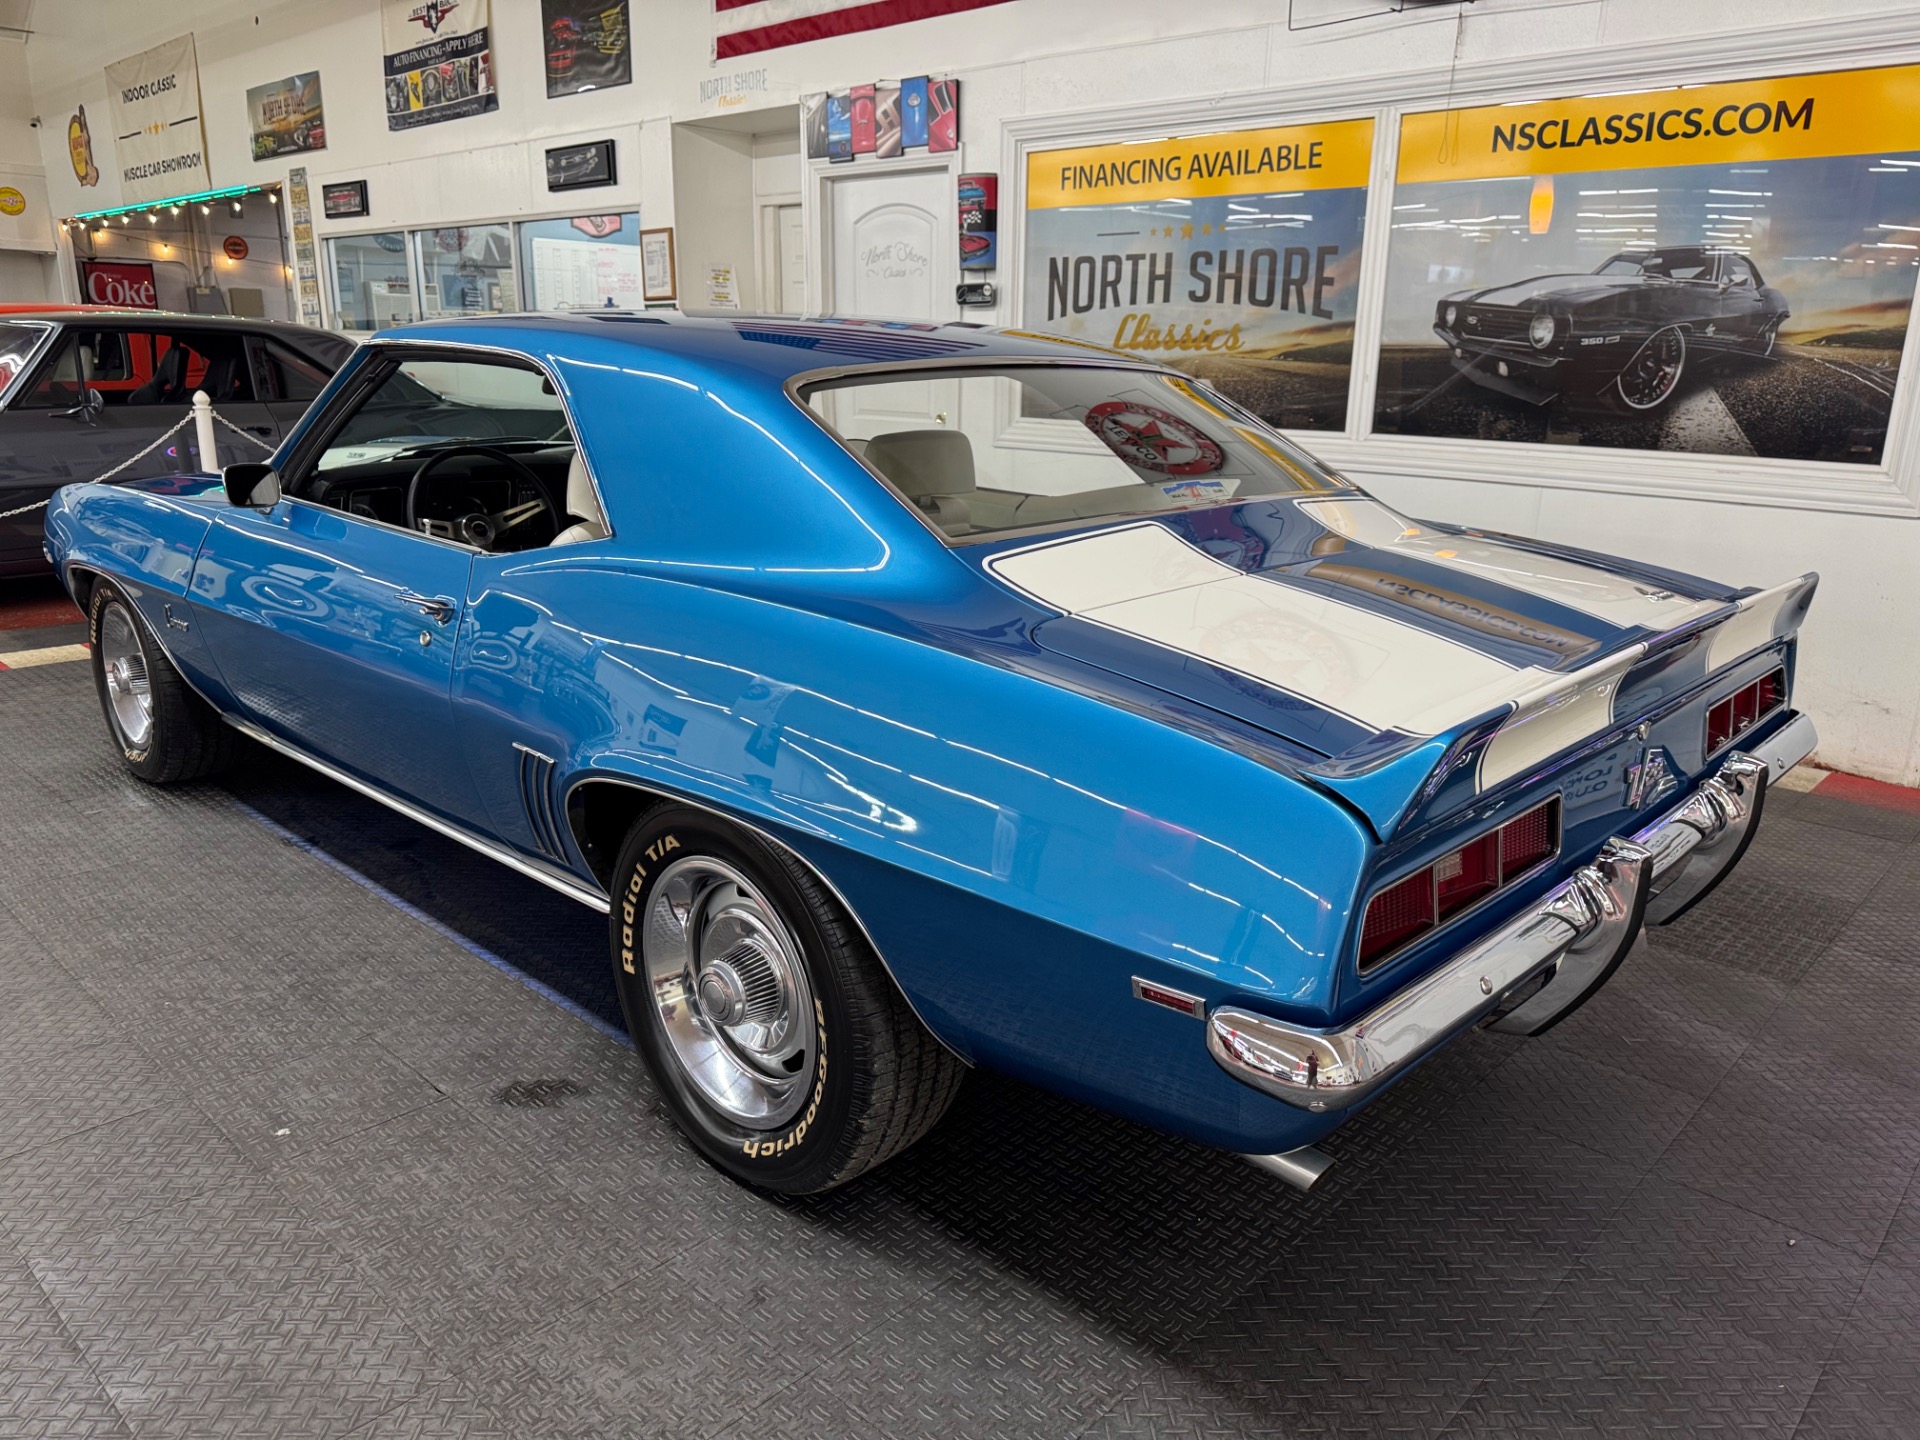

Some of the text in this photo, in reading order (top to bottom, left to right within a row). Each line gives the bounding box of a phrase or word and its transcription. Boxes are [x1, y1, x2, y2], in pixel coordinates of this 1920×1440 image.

[393, 53, 410, 68] AUTO
[409, 43, 443, 63] FINANCING
[445, 38, 468, 53] APPLY
[467, 31, 484, 47] HERE
[121, 74, 177, 104] INDOOR CLASSIC
[699, 68, 768, 103] NORTH SHORE
[1491, 97, 1815, 153] NSCLASSICS.COM
[123, 151, 202, 182] MUSCLE CAR SHOWROOM
[1060, 141, 1324, 191] FINANCING AVAILABLE
[87, 271, 156, 305] Coke
[1047, 245, 1340, 322] NORTH SHORE
[1112, 313, 1247, 353] Classics
[622, 832, 681, 976] Radial T/A
[742, 997, 830, 1159] BFGoodrich
